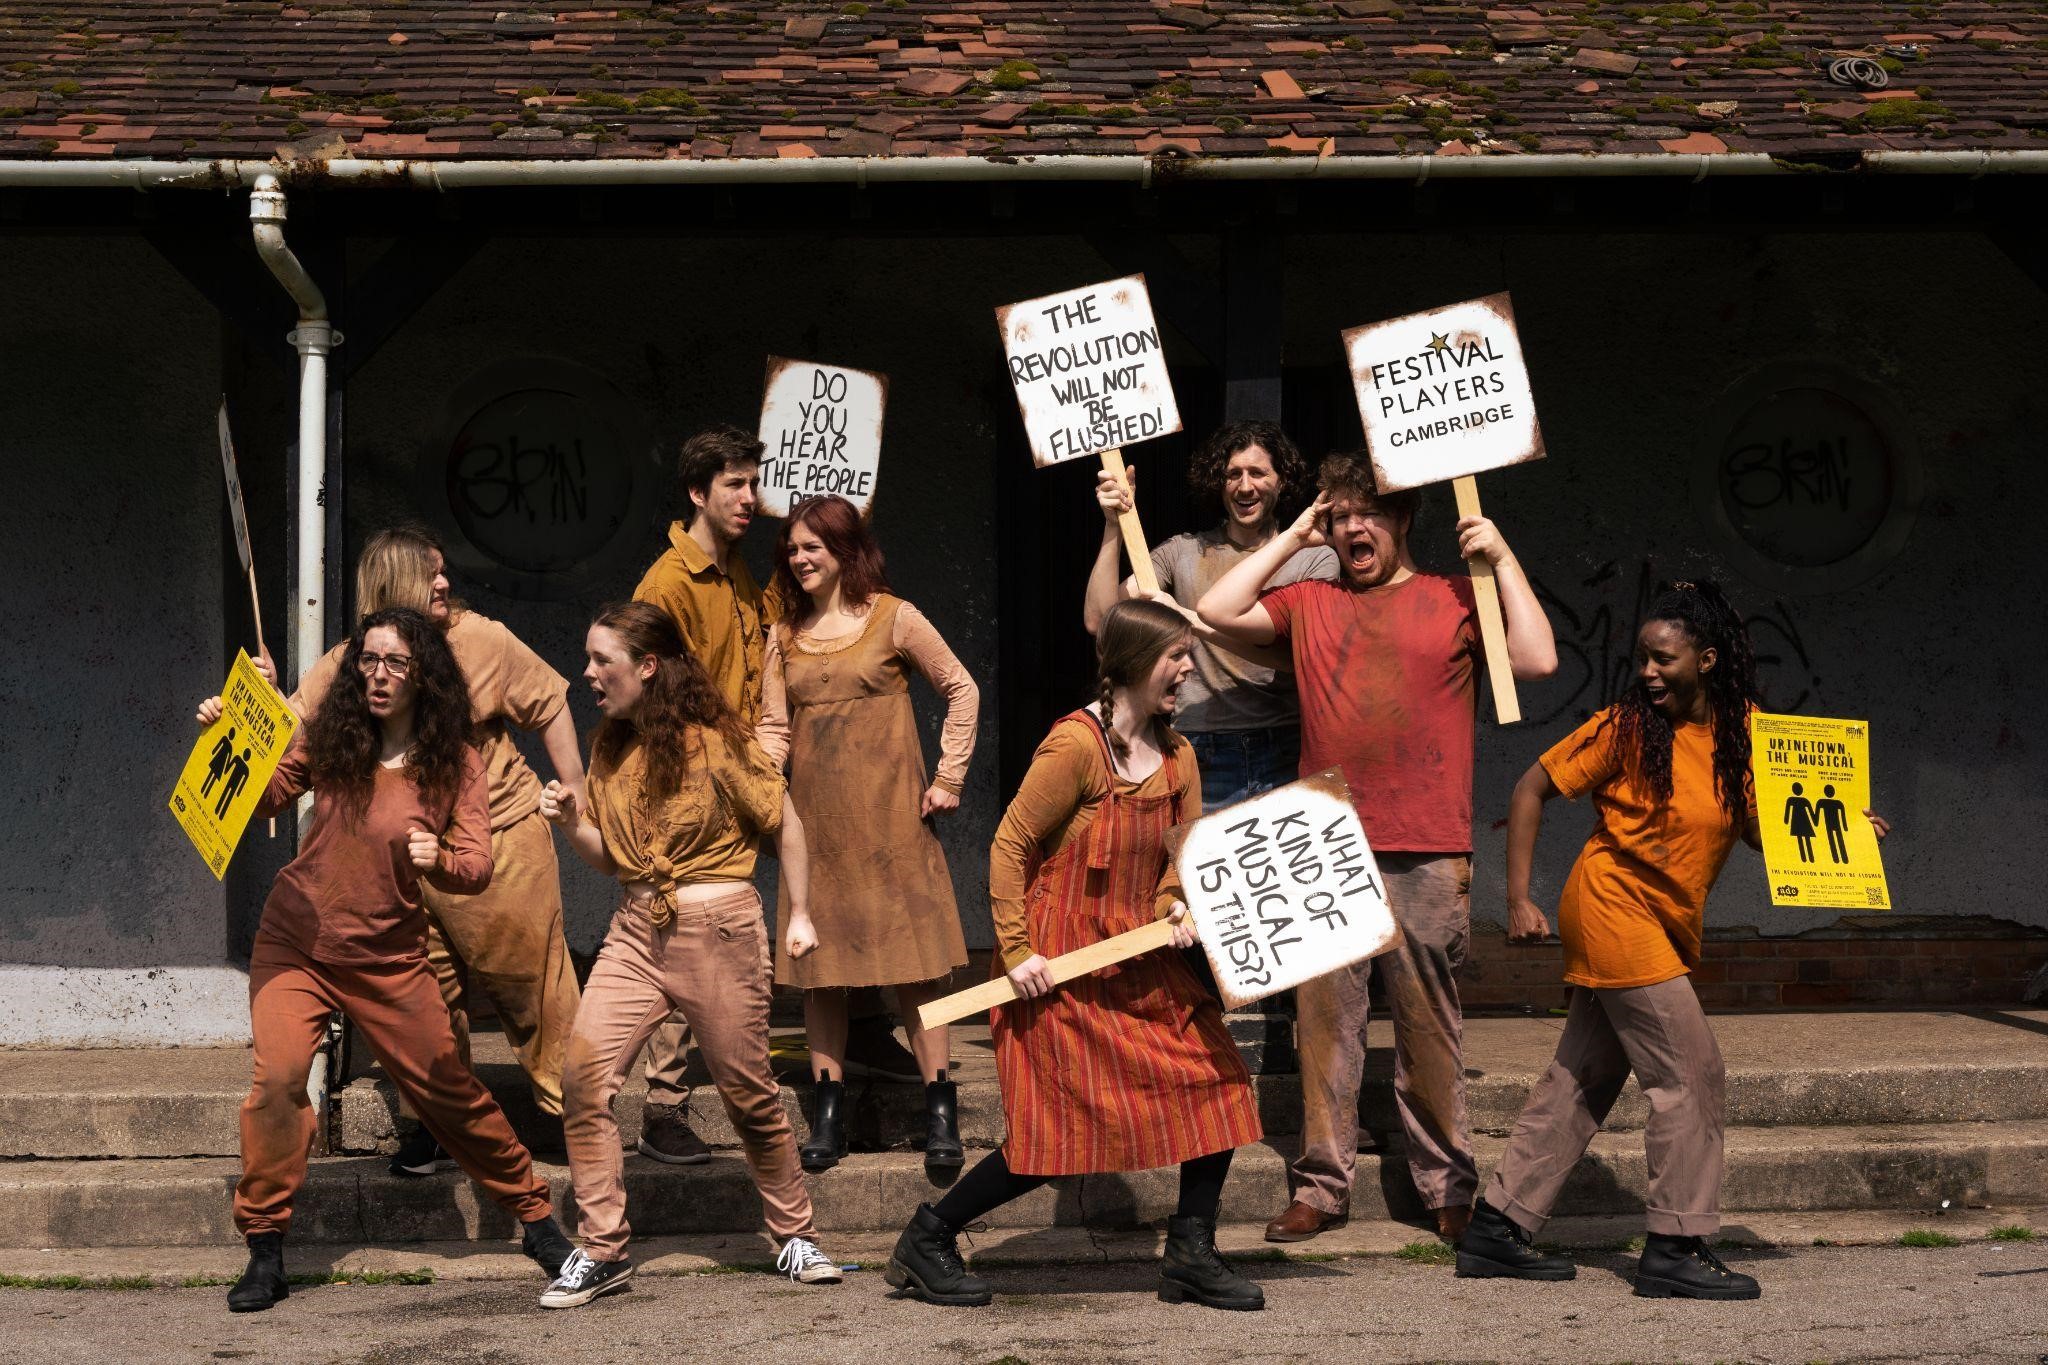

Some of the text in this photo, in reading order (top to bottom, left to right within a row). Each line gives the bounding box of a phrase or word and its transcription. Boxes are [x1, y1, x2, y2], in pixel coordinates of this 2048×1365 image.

[1041, 294, 1101, 333] THE
[1009, 326, 1160, 385] REVOLUTION
[1371, 336, 1504, 390] FESTIVAL
[813, 369, 847, 403] DO
[1051, 363, 1145, 406] WILL NOT
[1380, 371, 1505, 418] PLAYERS
[799, 401, 847, 435] YOU
[1082, 396, 1118, 425] BE
[1390, 404, 1514, 447] CAMBRIDGE
[780, 429, 848, 463] HEAR
[1049, 406, 1164, 460] FLUSHED!
[761, 457, 871, 496] THE PEOPLE
[229, 686, 243, 708] THE
[242, 706, 275, 752] MUSICAL
[1767, 751, 1856, 769] THE MUSICAL
[1769, 738, 1851, 757] URINETOWN,
[1272, 810, 1348, 930] KIND OF
[1321, 815, 1382, 900] WHAT
[1224, 817, 1302, 966] MUSICAL
[1196, 858, 1272, 986] IS THIS??
